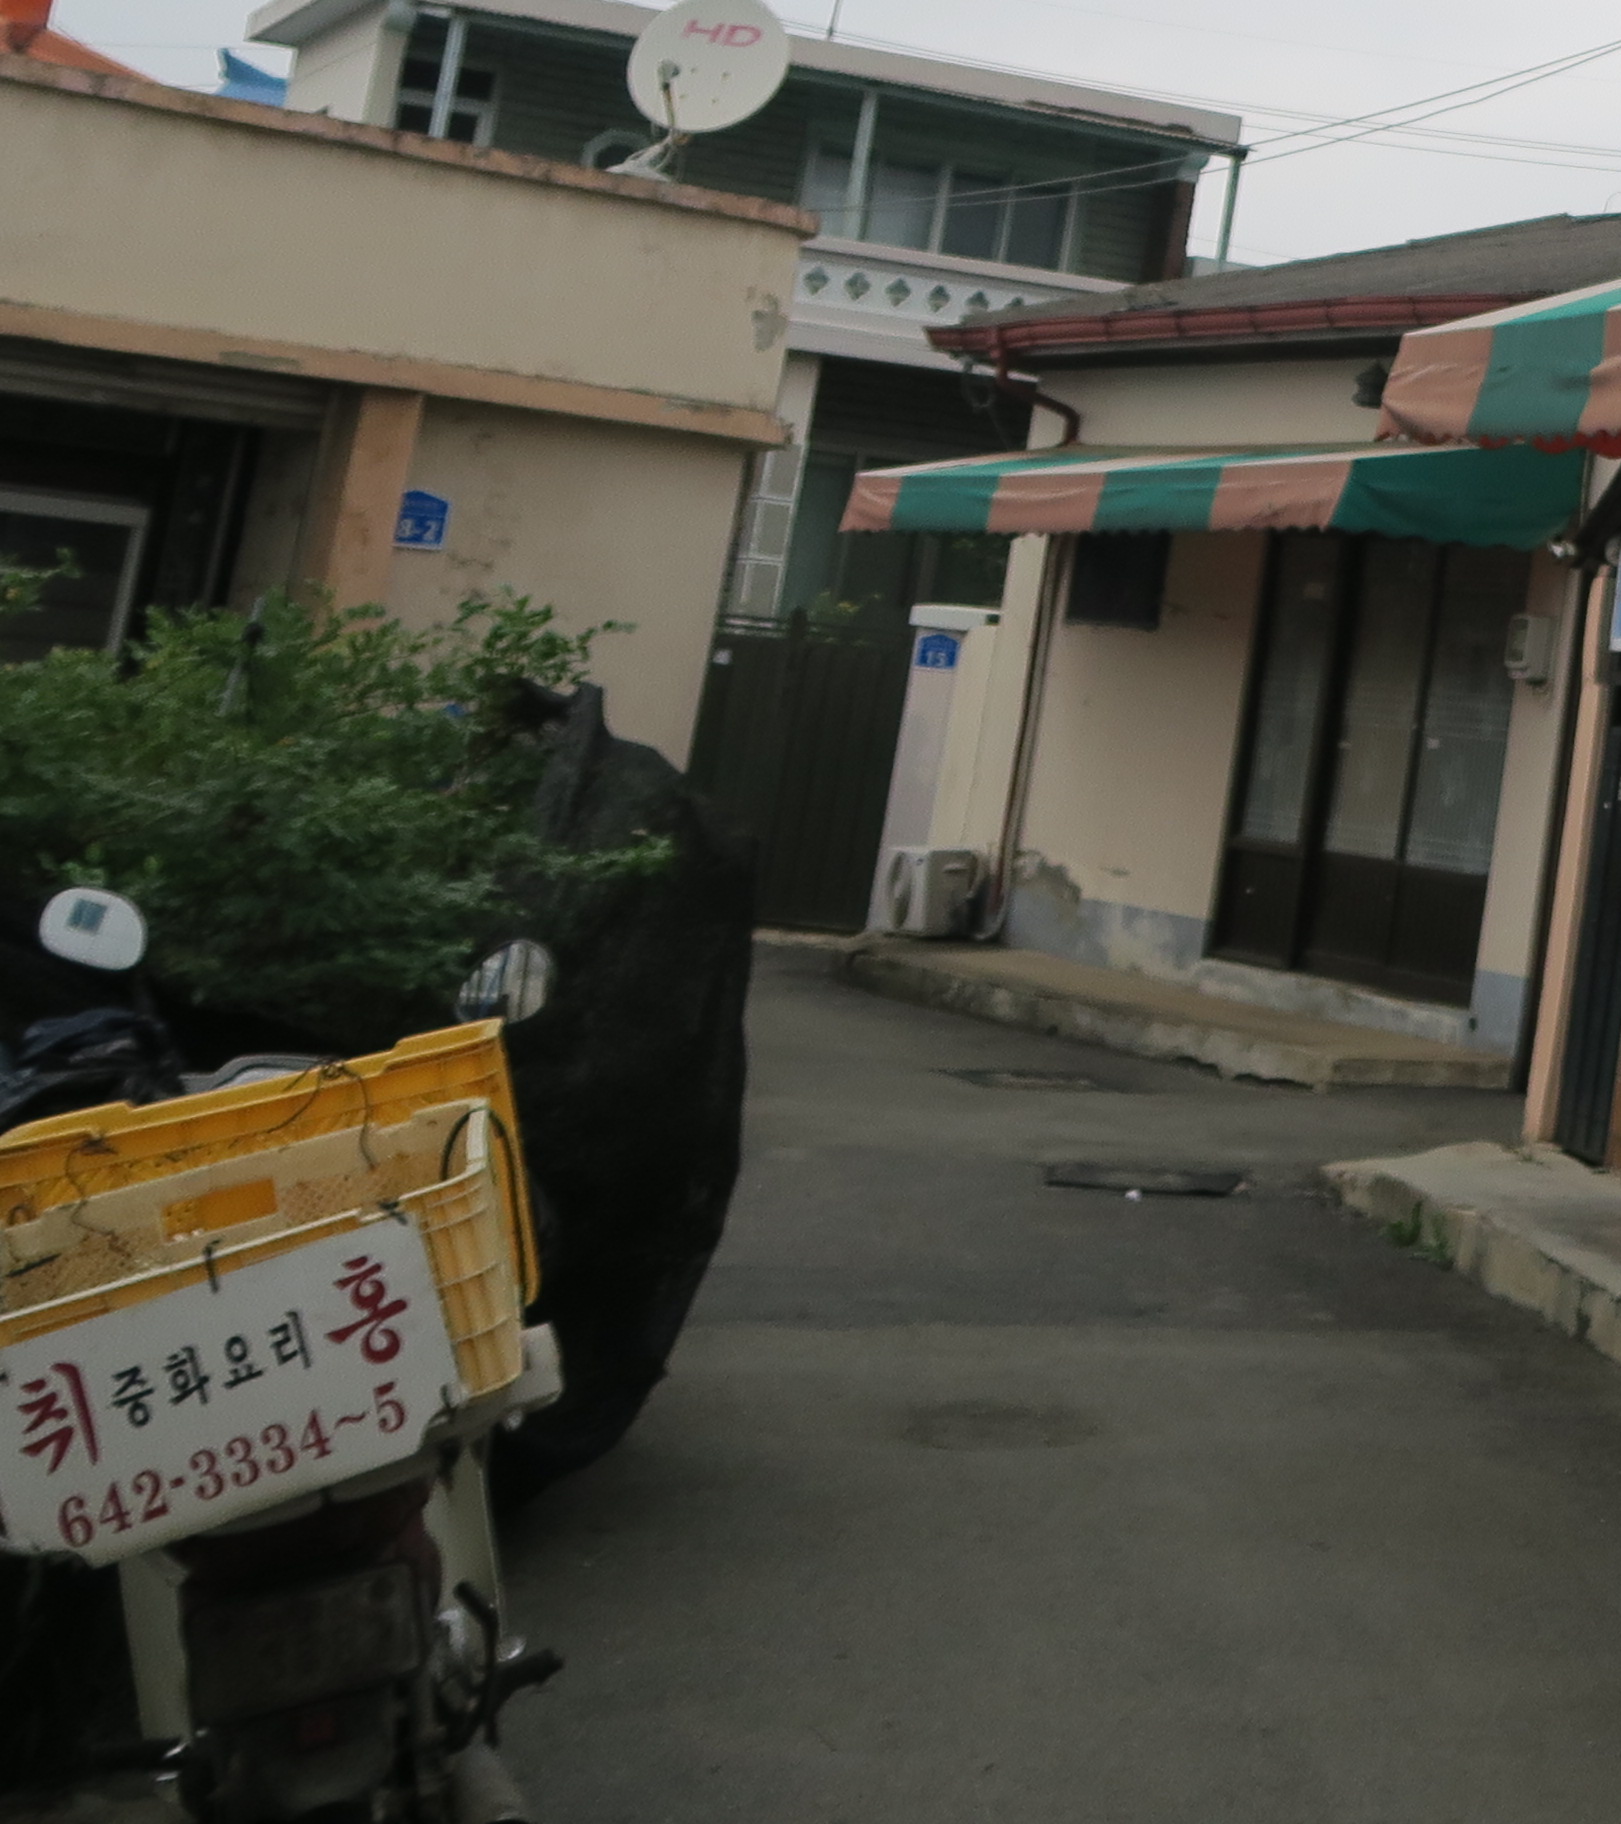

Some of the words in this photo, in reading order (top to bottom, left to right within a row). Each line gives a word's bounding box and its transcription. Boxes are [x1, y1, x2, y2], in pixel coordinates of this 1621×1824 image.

[682, 18, 763, 48] HD
[111, 1311, 313, 1427] 중화요리
[325, 1255, 409, 1364] 홍
[57, 1381, 406, 1548] 642-3334~5
